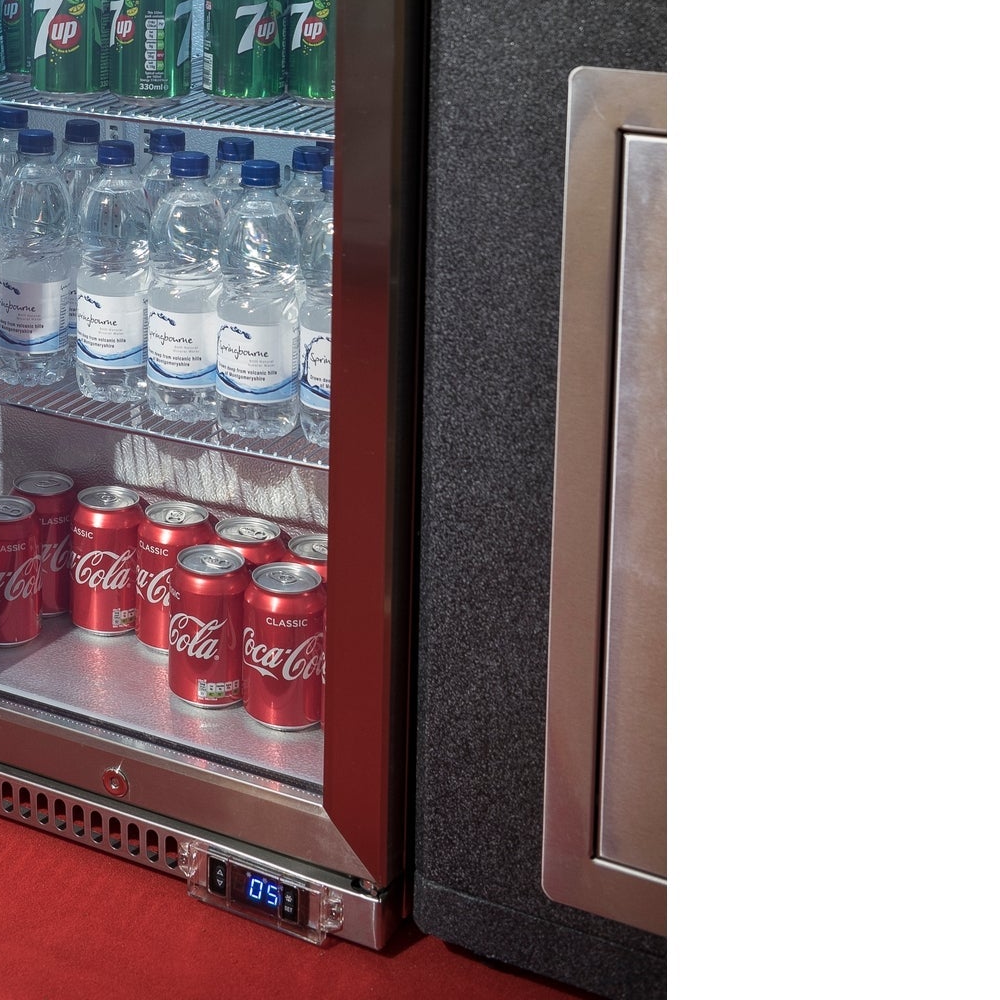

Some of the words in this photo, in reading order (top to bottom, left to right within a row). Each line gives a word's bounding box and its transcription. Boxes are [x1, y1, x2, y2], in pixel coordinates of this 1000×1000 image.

[139, 83, 163, 91] 330ml
[266, 616, 308, 628] CLASSIC
[250, 878, 278, 906] 05
